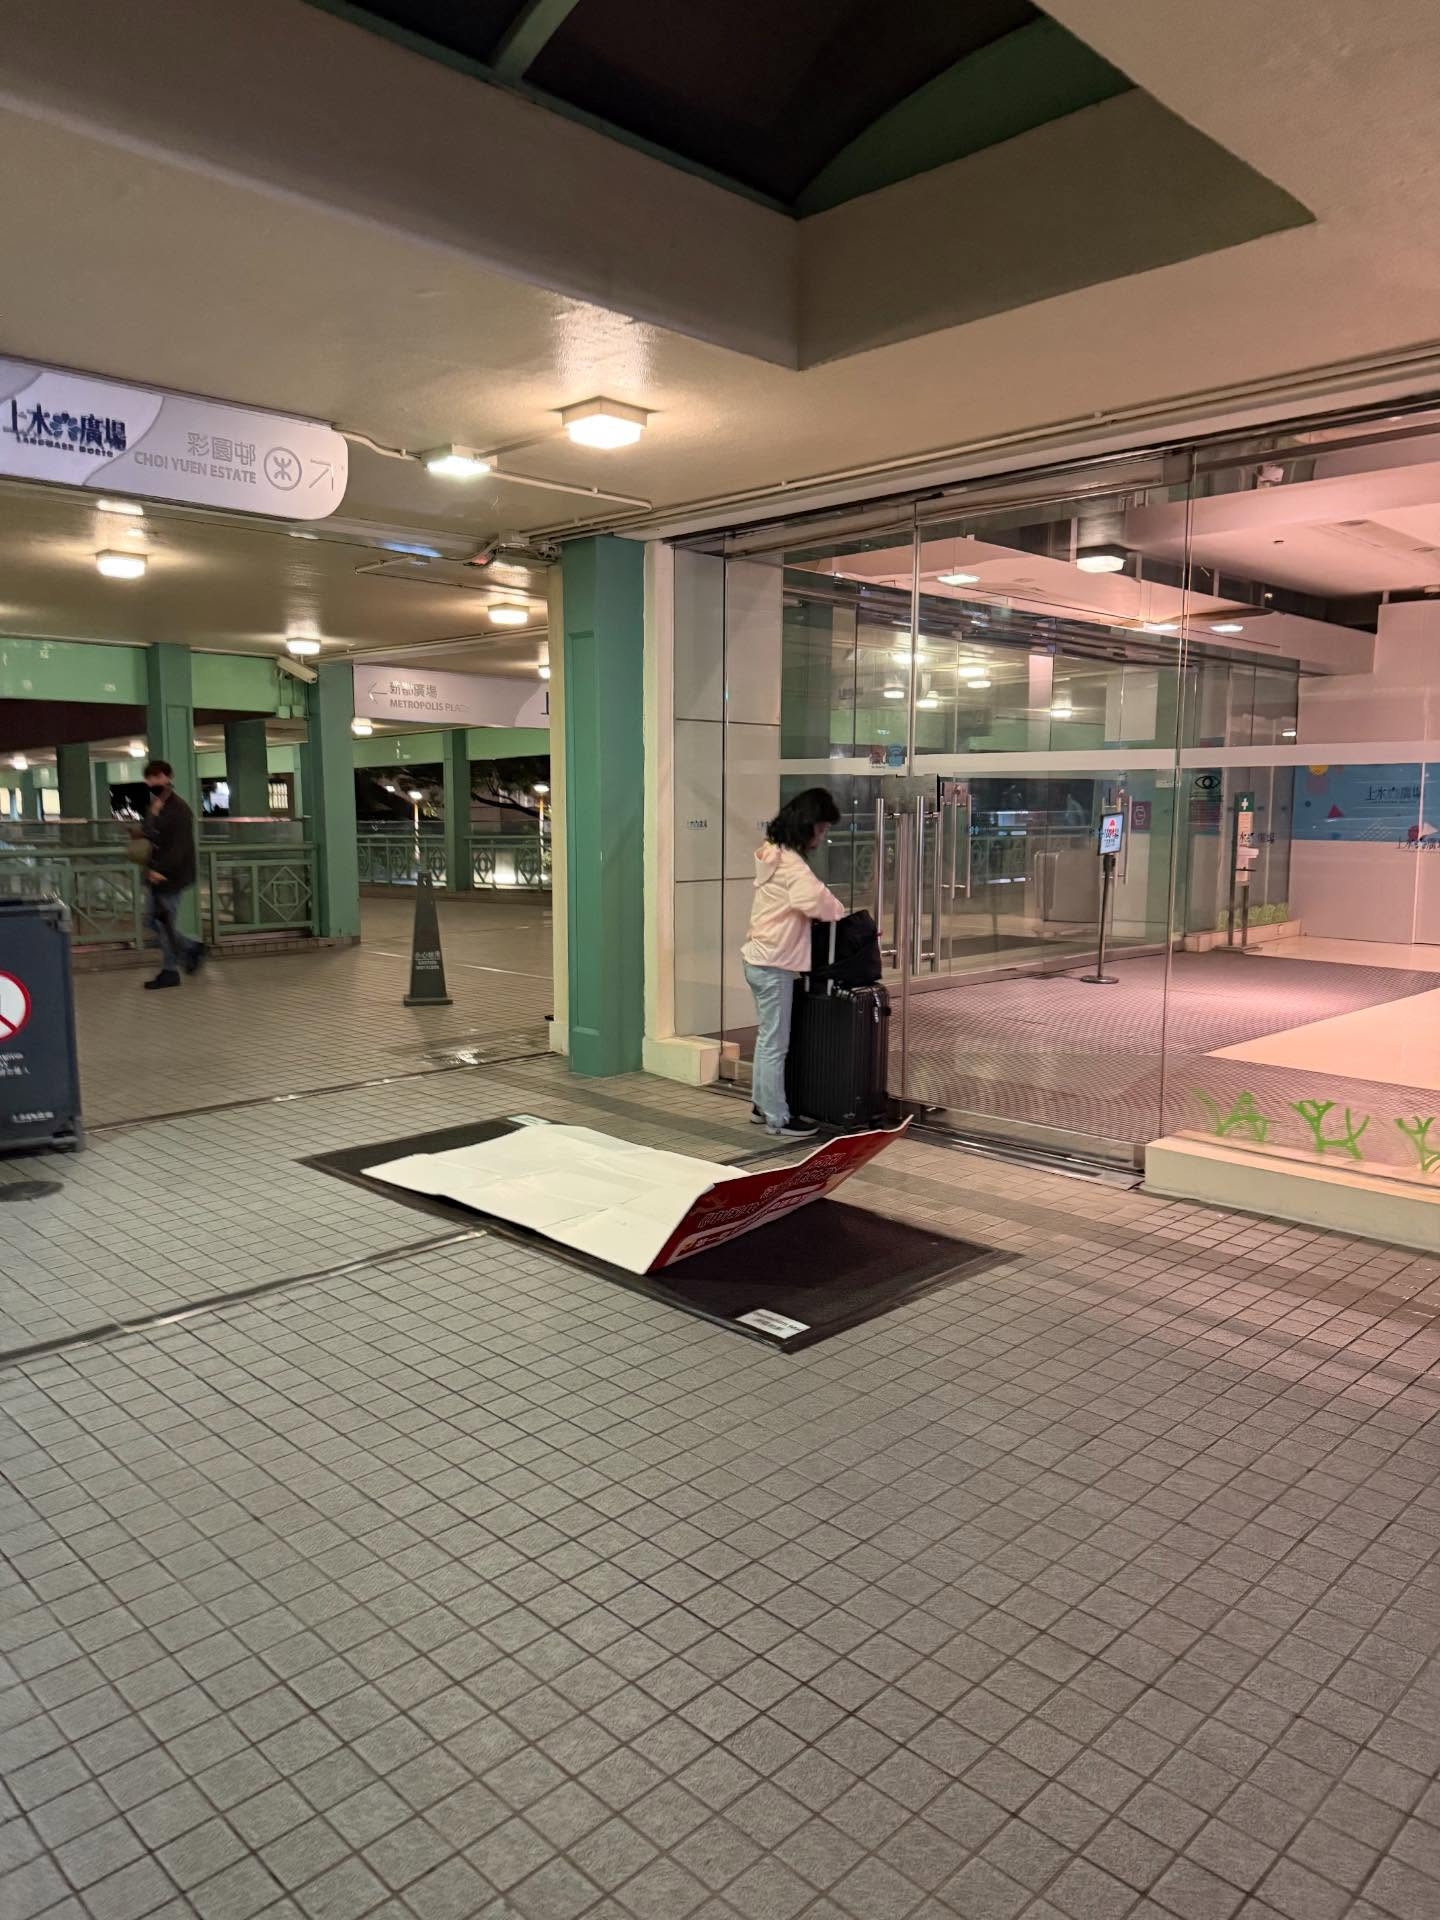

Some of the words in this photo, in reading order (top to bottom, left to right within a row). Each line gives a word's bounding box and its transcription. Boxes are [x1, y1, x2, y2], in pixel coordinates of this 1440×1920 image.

[134, 451, 168, 470] CHOI
[171, 457, 207, 476] YUEN
[210, 464, 257, 485] ESTATE
[390, 698, 444, 712] METROPOLIS
